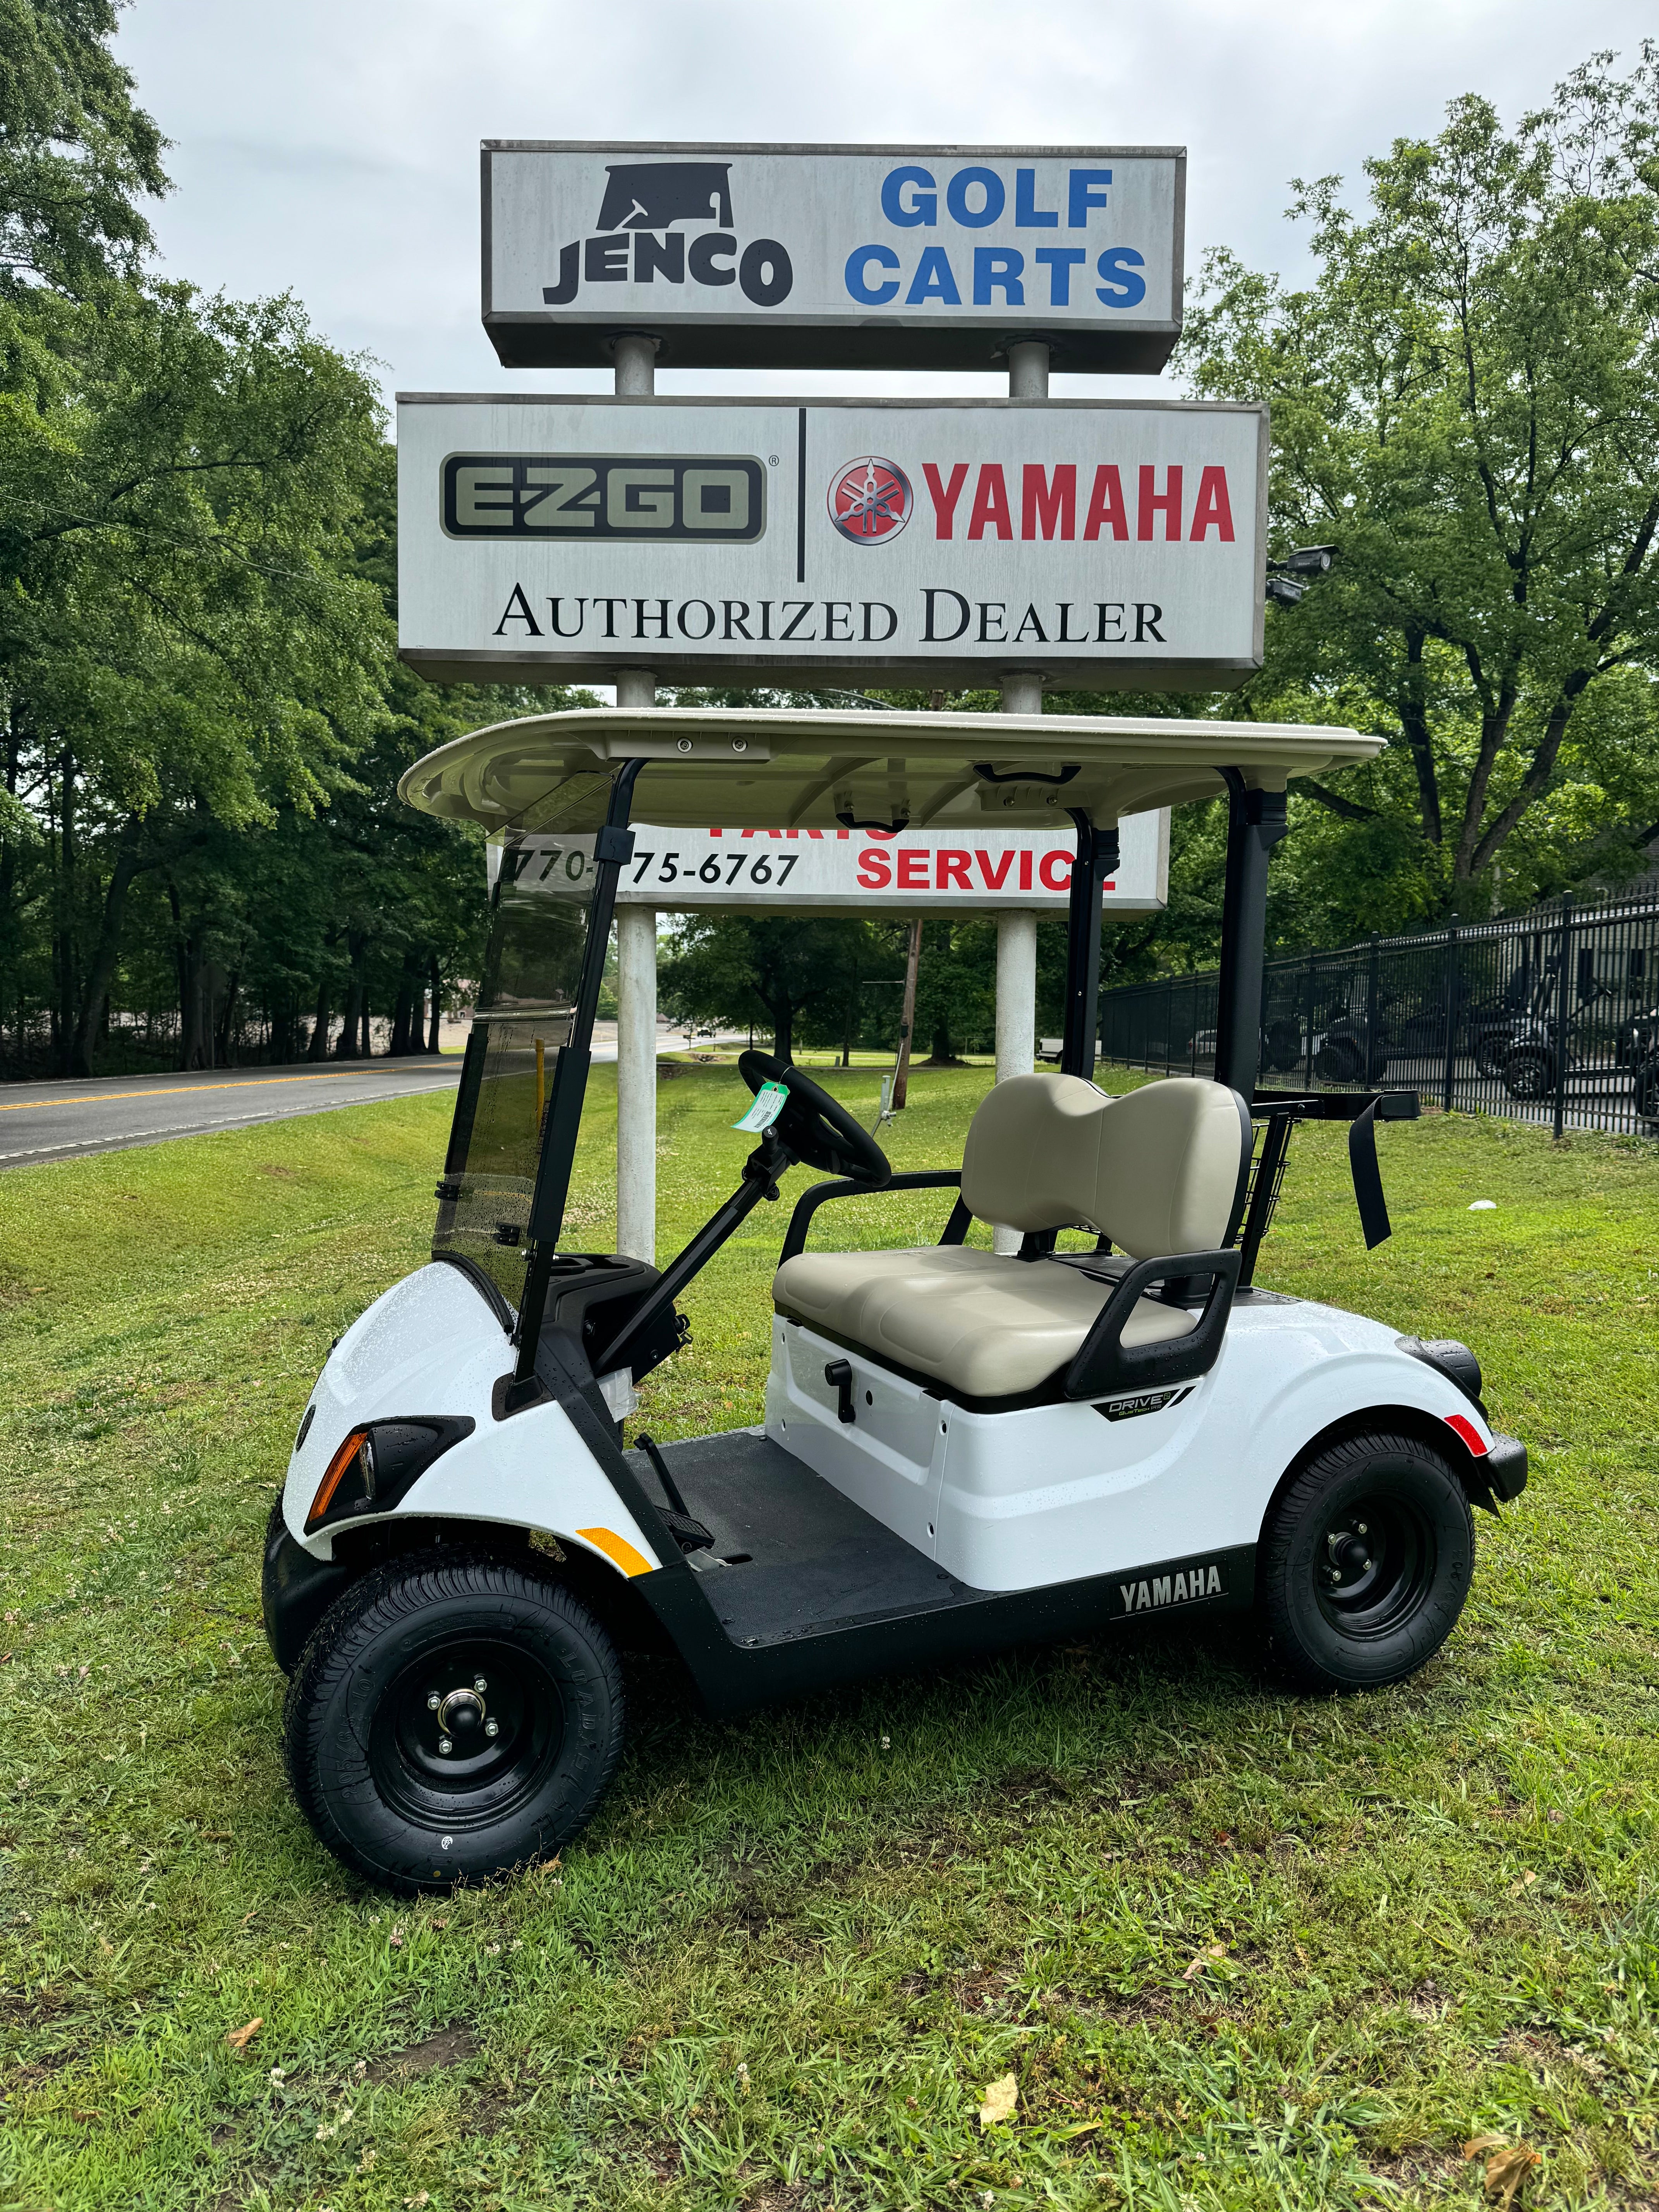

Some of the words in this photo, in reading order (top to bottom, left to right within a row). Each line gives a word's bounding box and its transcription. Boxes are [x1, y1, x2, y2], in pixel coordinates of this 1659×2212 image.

[881, 166, 1113, 228] GOLF
[542, 232, 793, 307] JENCO
[844, 244, 1146, 308] CARTS
[456, 467, 749, 529] EZGO
[922, 464, 1235, 541] YAMAHA
[514, 850, 799, 886] 770-75-6767
[856, 848, 1116, 891] SERVIC
[1120, 1566, 1221, 1612] YAMAHA
